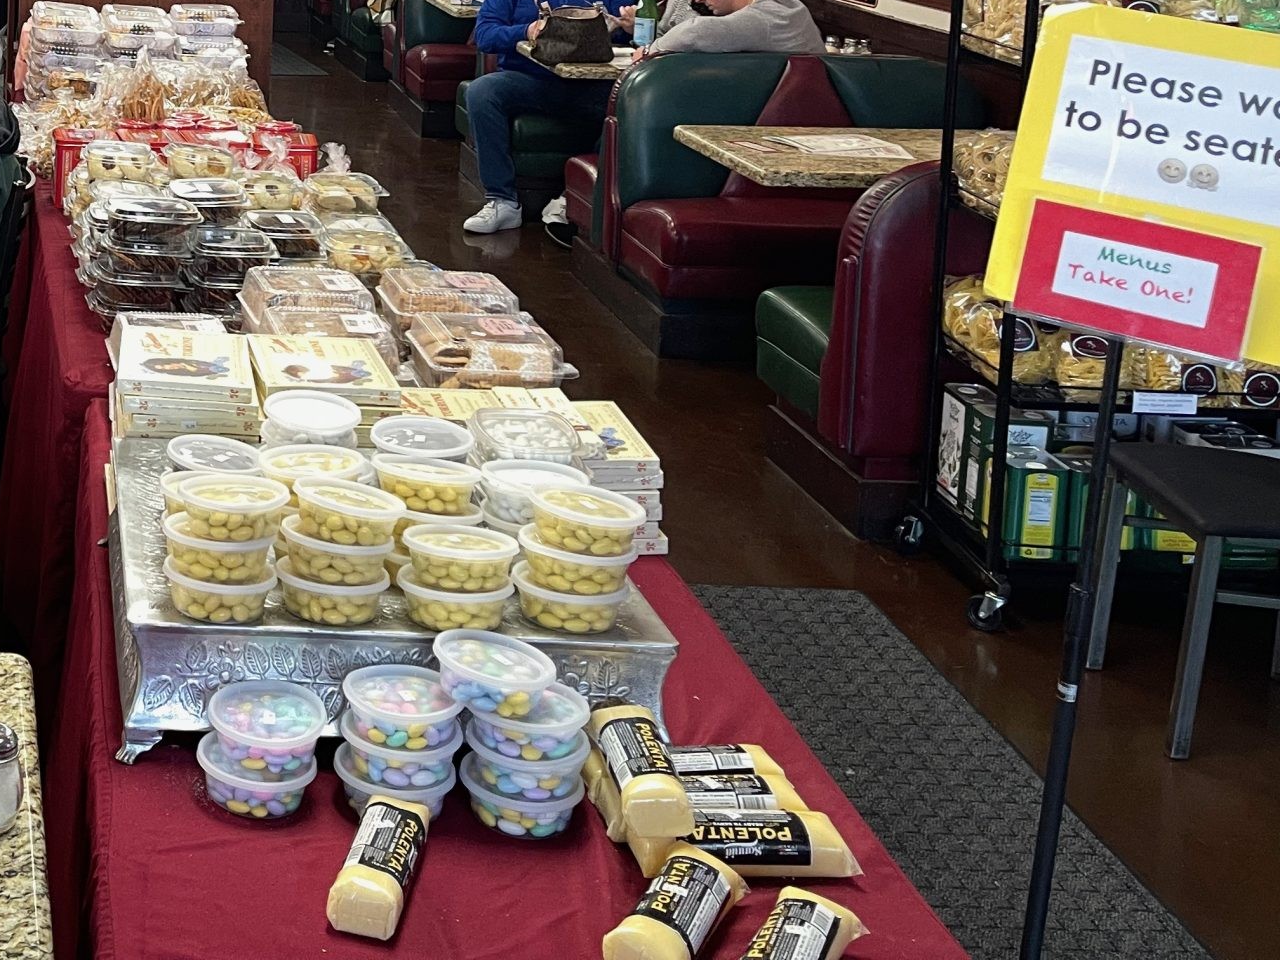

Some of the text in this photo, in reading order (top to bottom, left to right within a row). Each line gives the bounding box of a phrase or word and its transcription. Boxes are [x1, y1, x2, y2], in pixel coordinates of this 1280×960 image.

[1089, 59, 1223, 108] Please
[1065, 100, 1102, 132] to
[1117, 109, 1170, 145] be
[1097, 245, 1172, 274] Menus
[1068, 263, 1194, 305] Take One!
[636, 722, 669, 769] POLENTA
[388, 818, 419, 872] POLENTA
[693, 825, 792, 841] POLENTA
